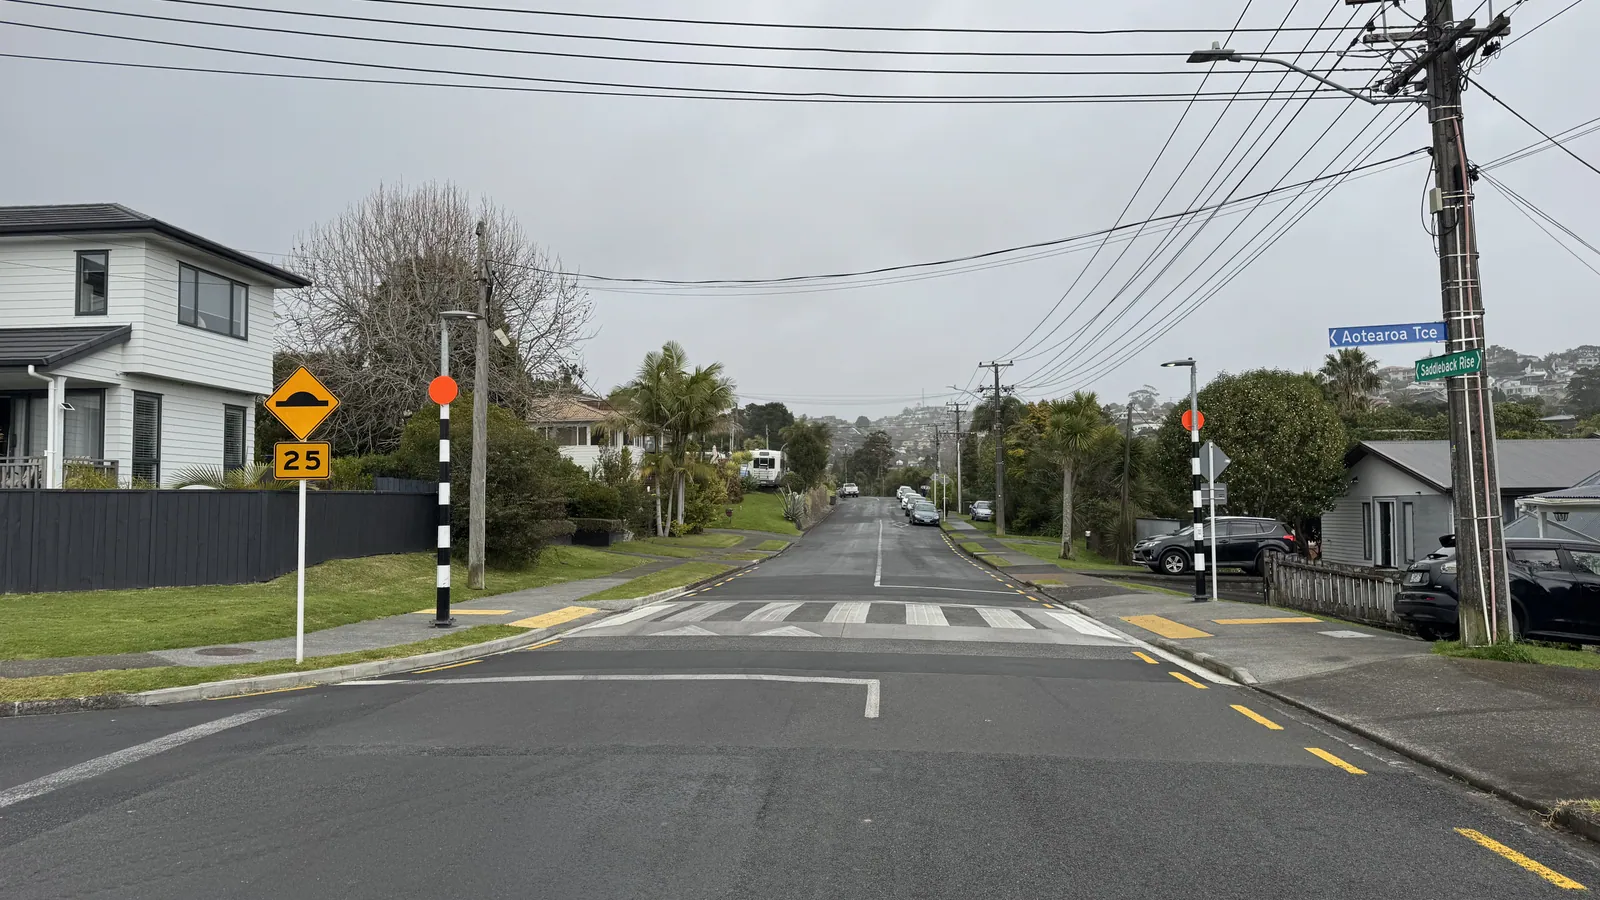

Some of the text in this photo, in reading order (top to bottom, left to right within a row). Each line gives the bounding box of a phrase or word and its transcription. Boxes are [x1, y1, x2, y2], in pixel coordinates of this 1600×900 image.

[1342, 326, 1438, 344] Aotearoa Tce
[1421, 355, 1475, 377] Saddleback Rise
[283, 450, 321, 471] 25
